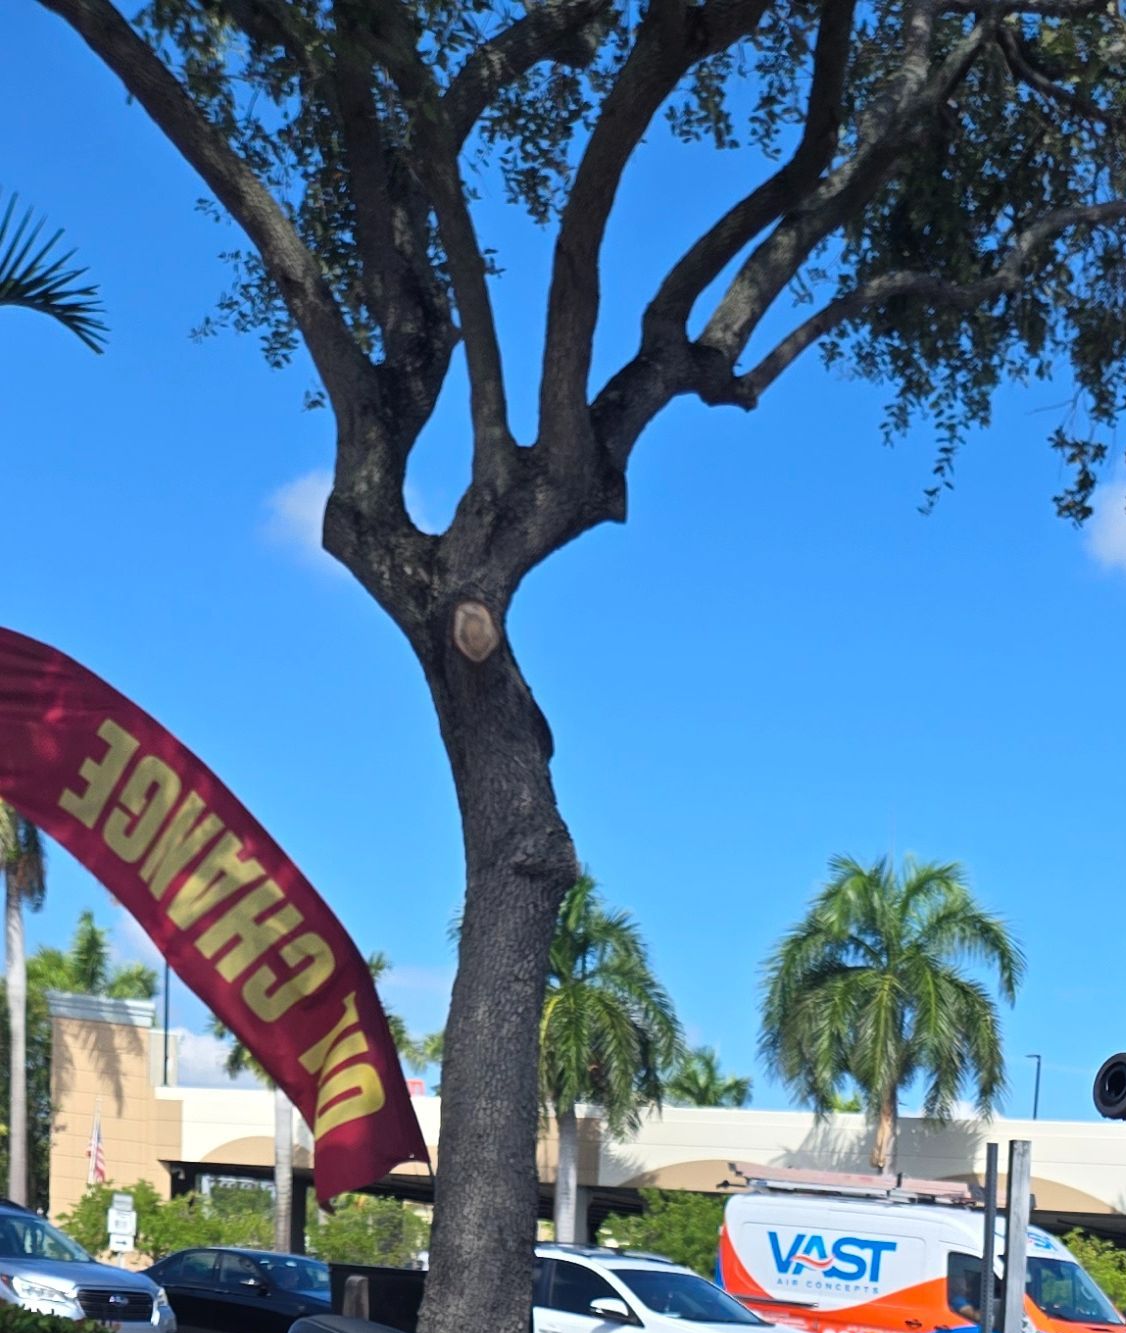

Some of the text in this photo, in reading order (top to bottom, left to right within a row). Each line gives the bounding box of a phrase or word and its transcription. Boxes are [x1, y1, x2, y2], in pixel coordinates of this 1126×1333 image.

[58, 718, 386, 1141] OIL CHANGE
[767, 1230, 898, 1283] VAST
[776, 1277, 880, 1295] AIR CONCEPTS
